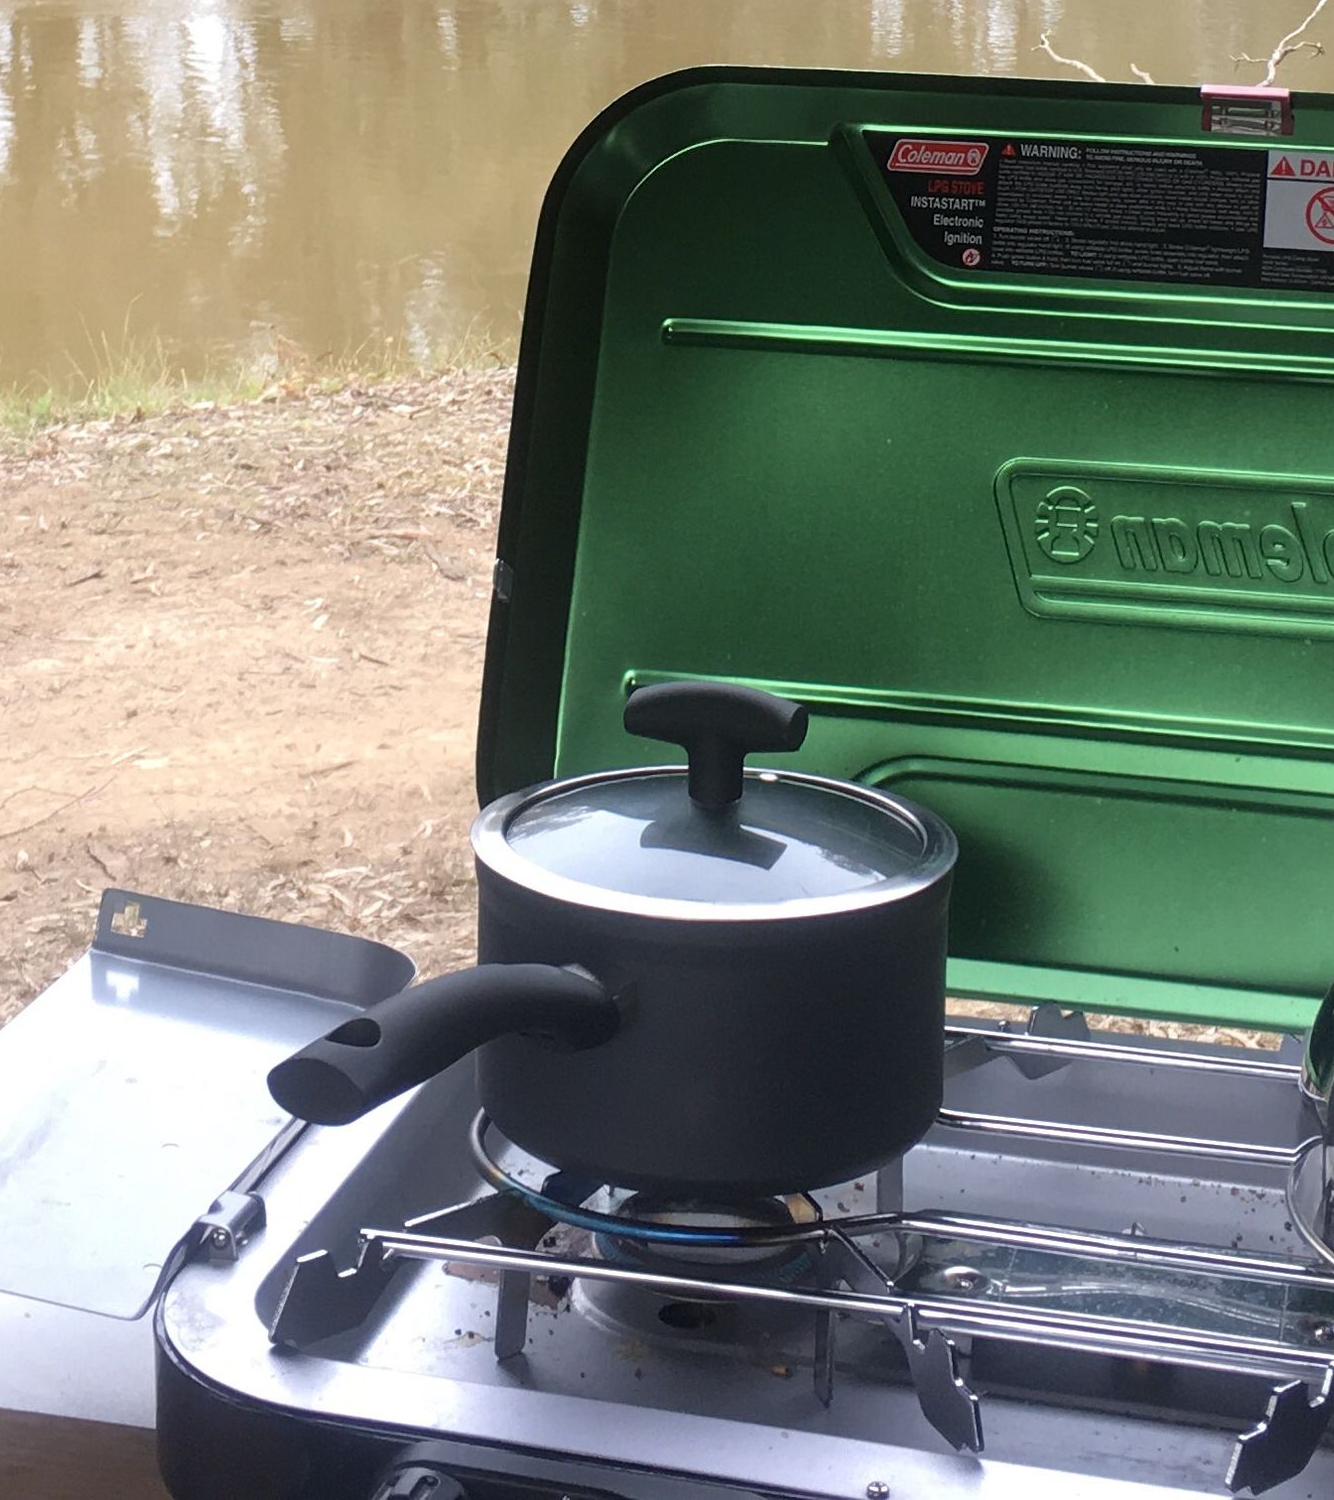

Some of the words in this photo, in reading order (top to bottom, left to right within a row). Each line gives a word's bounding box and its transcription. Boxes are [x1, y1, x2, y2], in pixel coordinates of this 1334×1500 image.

[897, 144, 965, 165] Coleman
[1020, 143, 1082, 159] WARNING:
[928, 180, 949, 193] LPG
[951, 181, 985, 195] STOVE
[933, 214, 984, 228] Electronic
[944, 231, 983, 246] Ignition
